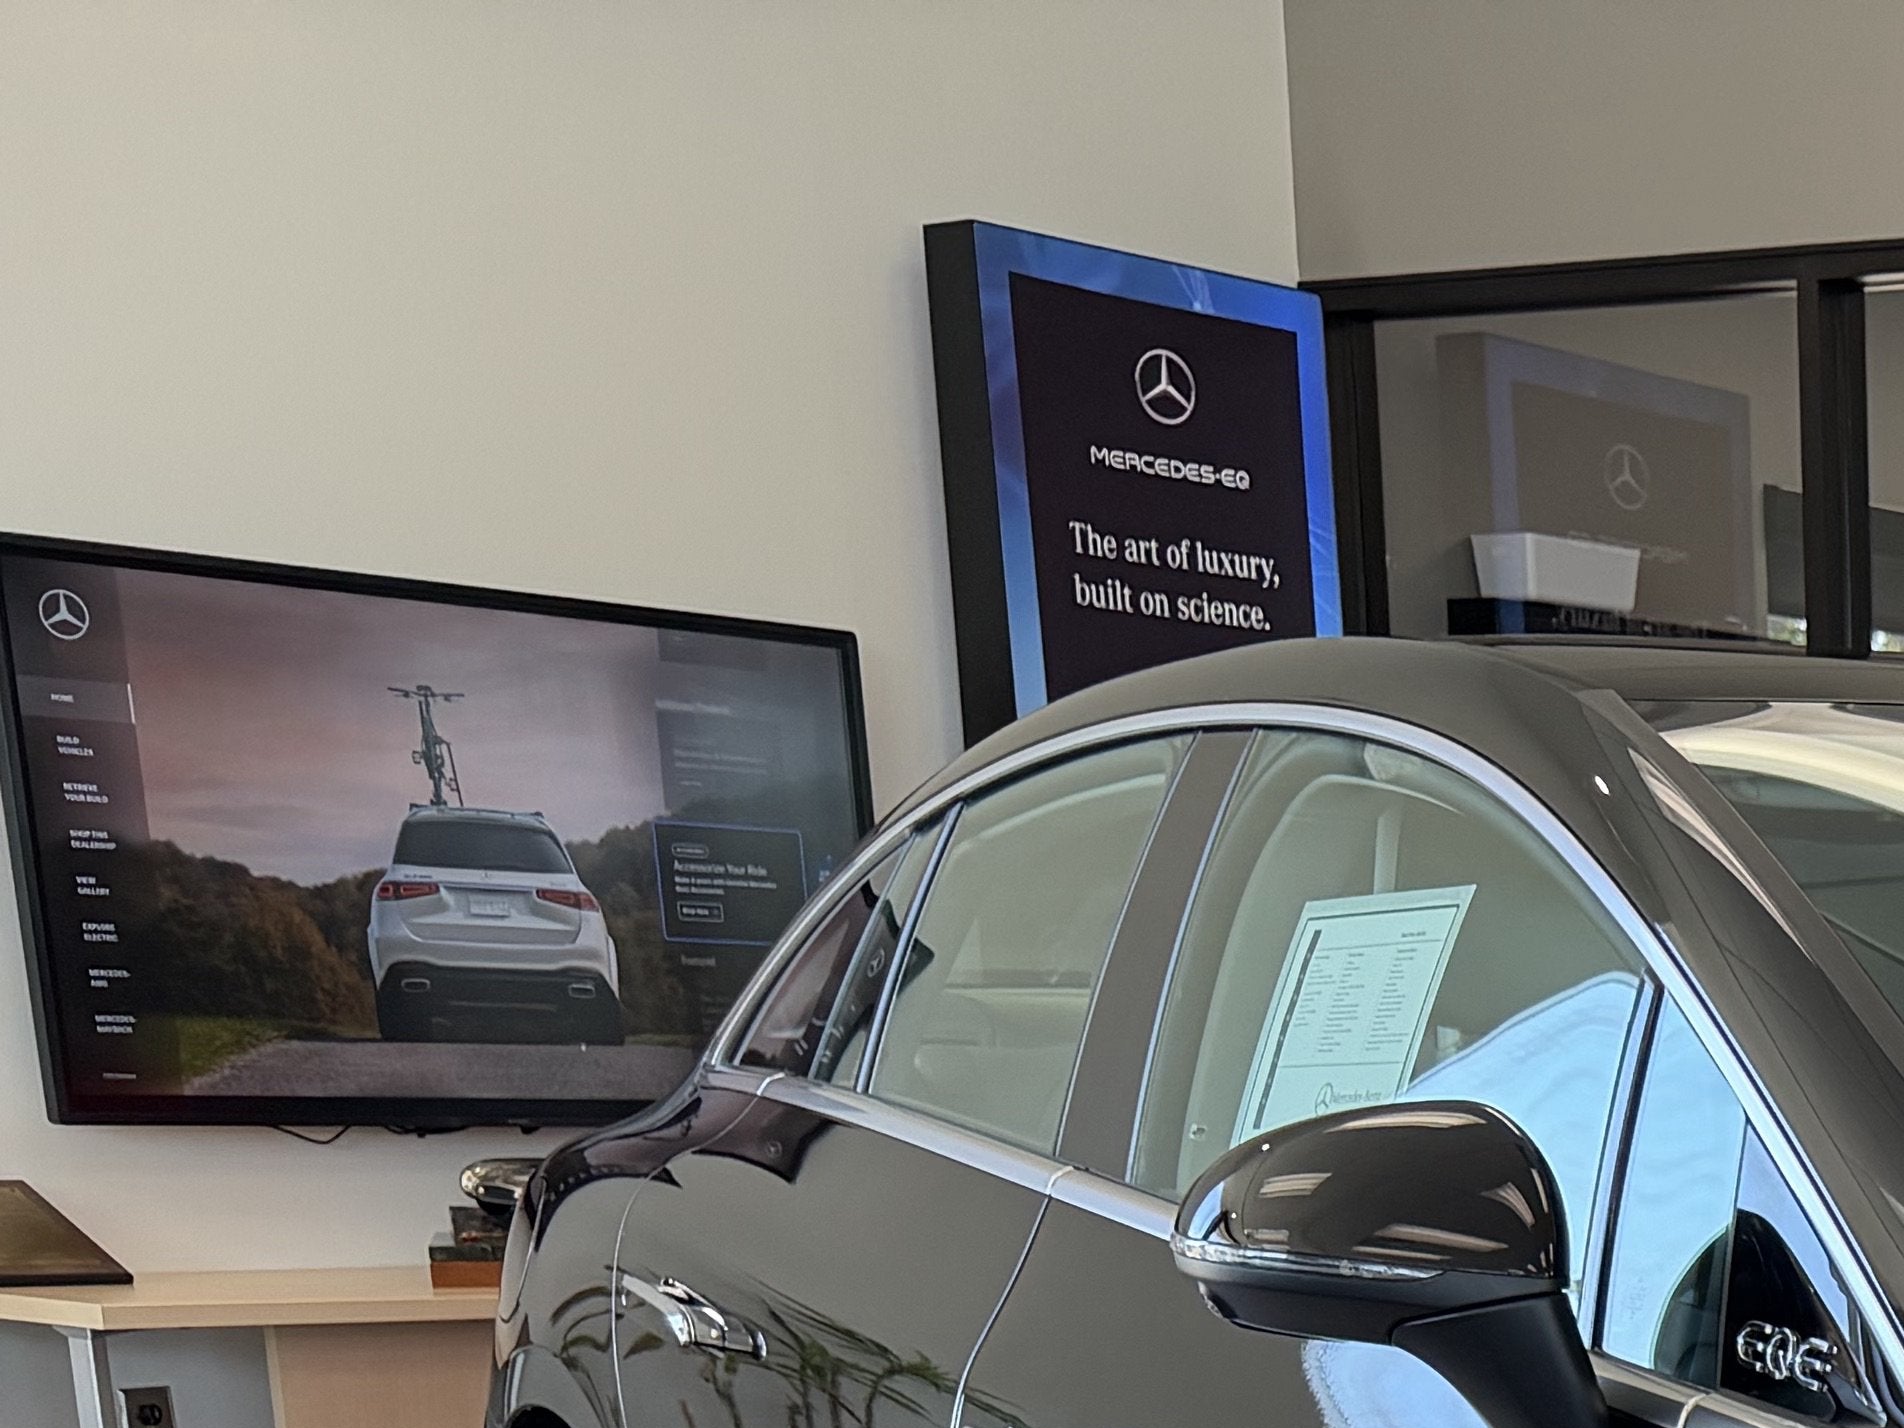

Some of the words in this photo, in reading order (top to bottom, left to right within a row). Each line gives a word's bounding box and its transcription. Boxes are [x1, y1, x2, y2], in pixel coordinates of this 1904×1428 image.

[1068, 520, 1117, 560] The
[1124, 537, 1161, 567] art
[1166, 538, 1191, 571] of
[1195, 540, 1280, 590] luxury,
[1073, 572, 1134, 614] built
[1139, 591, 1171, 618] on
[1177, 592, 1271, 631] science.
[1736, 1320, 1834, 1393] EQE
